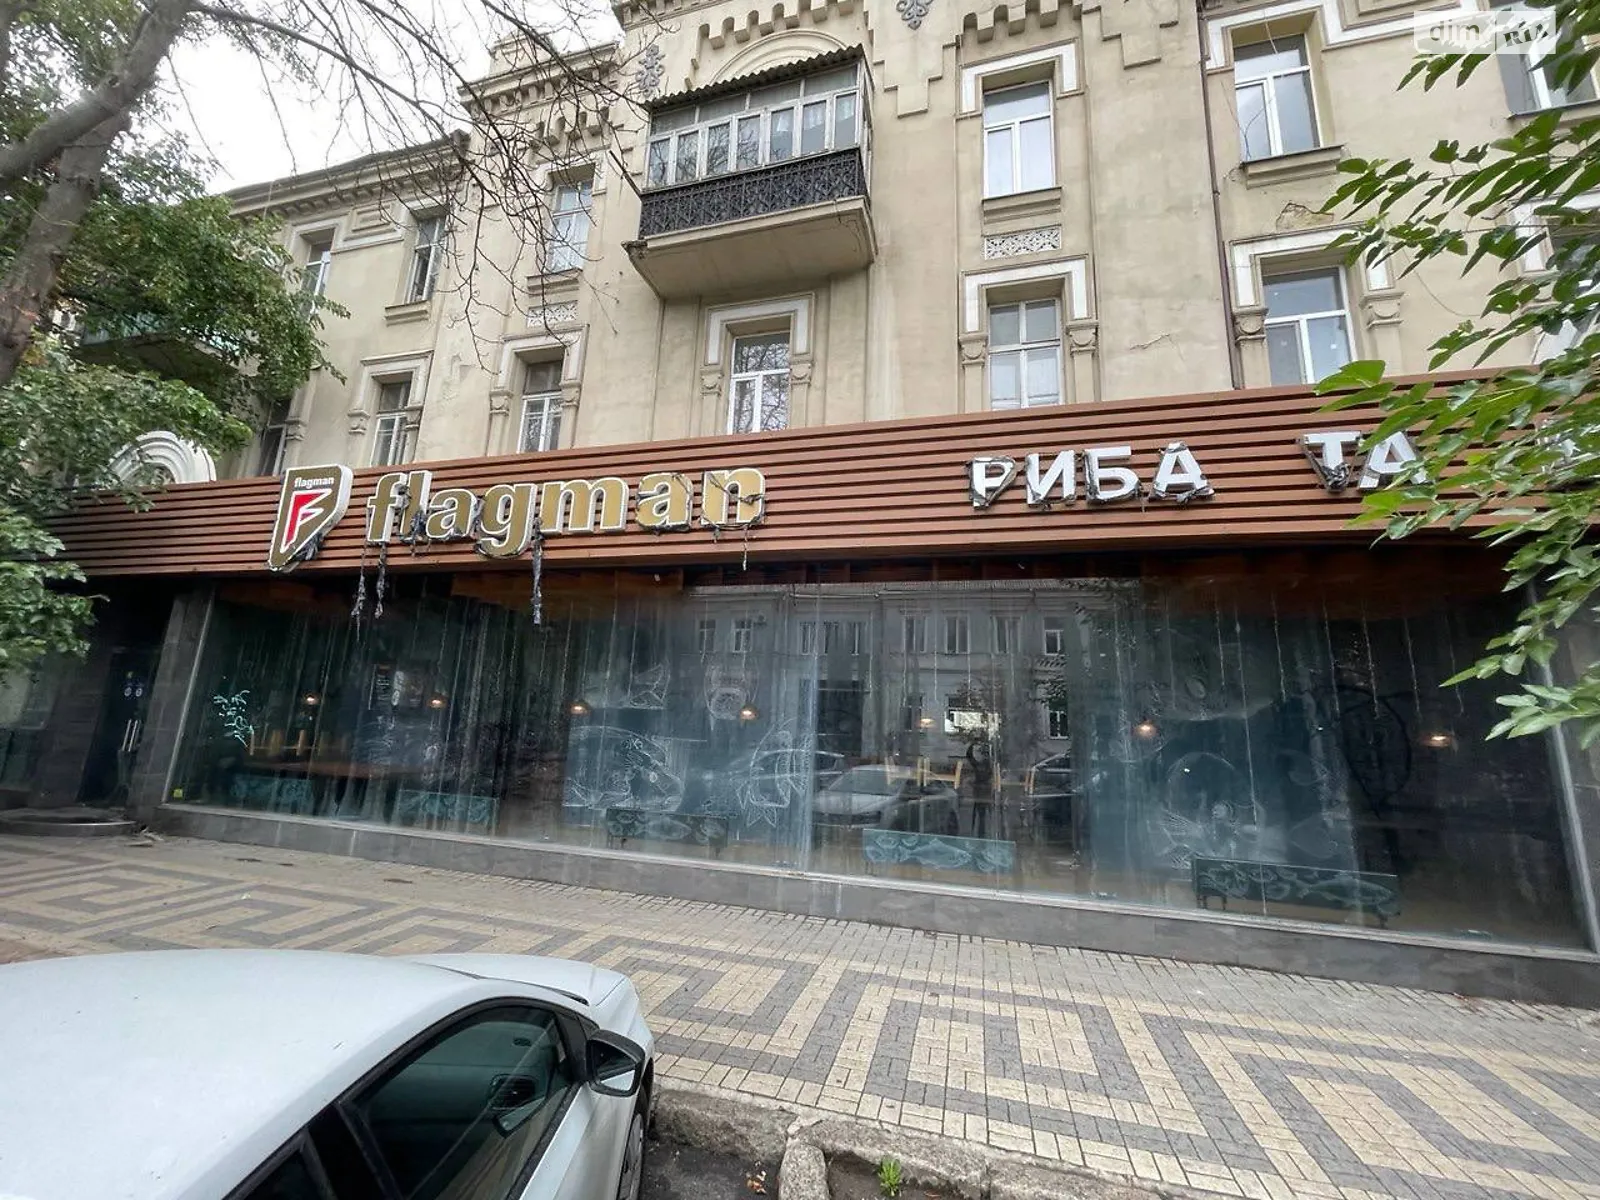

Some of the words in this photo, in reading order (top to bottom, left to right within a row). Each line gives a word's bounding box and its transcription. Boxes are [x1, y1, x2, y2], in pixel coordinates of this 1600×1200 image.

[294, 477, 335, 489] flagman
[968, 442, 1214, 508] РИБА
[1303, 430, 1429, 491] ТА
[367, 468, 767, 559] flagman
